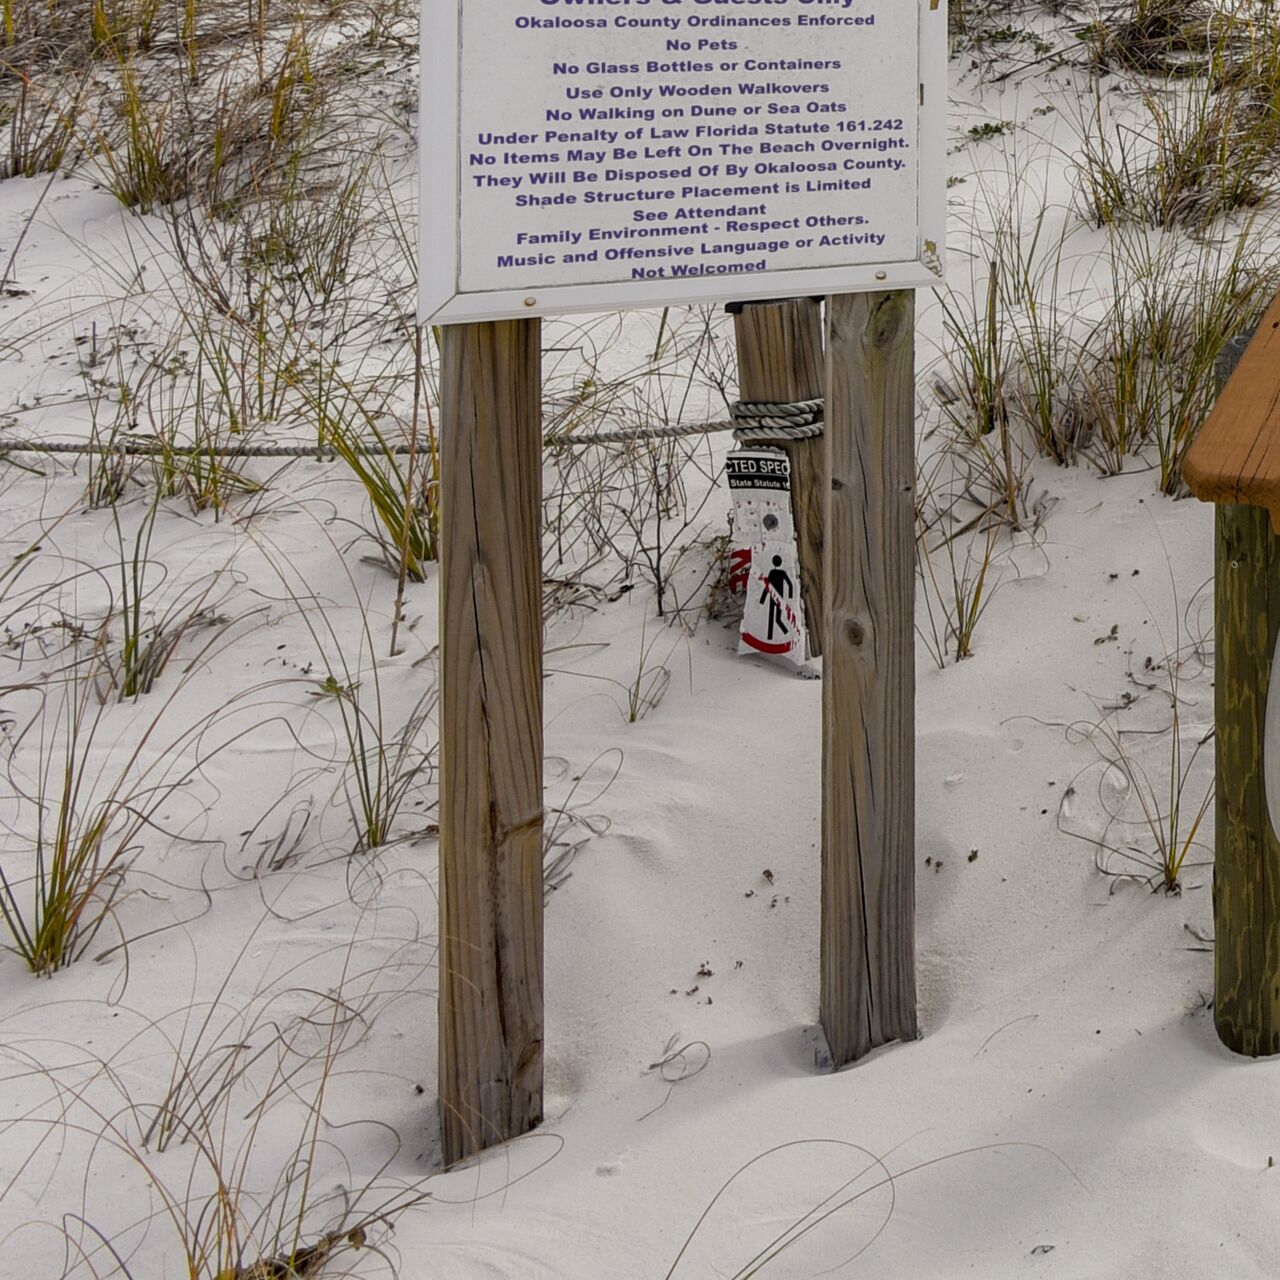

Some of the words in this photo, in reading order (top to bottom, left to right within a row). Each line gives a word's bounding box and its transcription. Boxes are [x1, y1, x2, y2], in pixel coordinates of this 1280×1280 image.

[514, 15, 608, 29] Okaloosa
[613, 15, 682, 31] County
[686, 14, 792, 28] Ordinances
[797, 13, 875, 27] Enforced
[665, 38, 692, 52] No
[697, 38, 738, 51] Pets
[552, 62, 580, 75] No
[585, 61, 640, 75] Glass
[646, 60, 714, 73] Bottles
[719, 62, 740, 72] or
[743, 58, 842, 72] Containers
[566, 87, 604, 100] Use
[609, 85, 654, 101] Only
[658, 83, 733, 97] Wooden
[737, 82, 830, 95] Walkovers
[545, 108, 573, 122] No
[578, 106, 656, 122] Walking
[661, 108, 685, 118] on
[690, 104, 738, 117] Dune
[742, 105, 763, 116] or
[767, 102, 801, 115] Sea
[806, 101, 847, 114] Oats
[478, 131, 540, 146] Under
[544, 128, 619, 144] Penalty
[624, 127, 644, 141] of
[650, 126, 690, 140] Law
[695, 123, 759, 138] Florida
[764, 121, 831, 135] Statute
[836, 118, 904, 133] 161.242
[469, 153, 497, 166] No
[503, 151, 561, 165] Items
[566, 149, 607, 164] May
[612, 147, 638, 161] Be
[644, 145, 682, 159] Left
[687, 144, 713, 157] On
[718, 143, 754, 156] The
[759, 140, 816, 154] Beach
[820, 137, 910, 152] Overnight.
[472, 174, 524, 189] They
[528, 171, 566, 185] Will
[572, 170, 599, 183] Be
[604, 165, 692, 184] Disposed
[697, 164, 720, 178] Of
[725, 163, 749, 179] By
[753, 161, 838, 175] Okaloosa
[842, 157, 906, 171] County.
[515, 192, 578, 207] Shade
[583, 189, 676, 204] Structure
[681, 182, 780, 199] Placement
[785, 181, 801, 194] is
[806, 177, 871, 193] Limited
[632, 209, 669, 223] See
[673, 203, 767, 220] Attendant
[516, 229, 583, 246] Family
[588, 222, 709, 241] Environment
[726, 217, 800, 234] Respect
[805, 214, 870, 228] Others.
[496, 252, 556, 268] Music
[562, 249, 598, 264] and
[604, 244, 695, 261] Offensive
[700, 240, 790, 256] Language
[795, 238, 814, 249] or
[818, 232, 887, 249] Activity
[631, 266, 665, 280] Not
[671, 259, 767, 277] Welcomed
[730, 479, 753, 488] State
[754, 479, 781, 488] Statute
